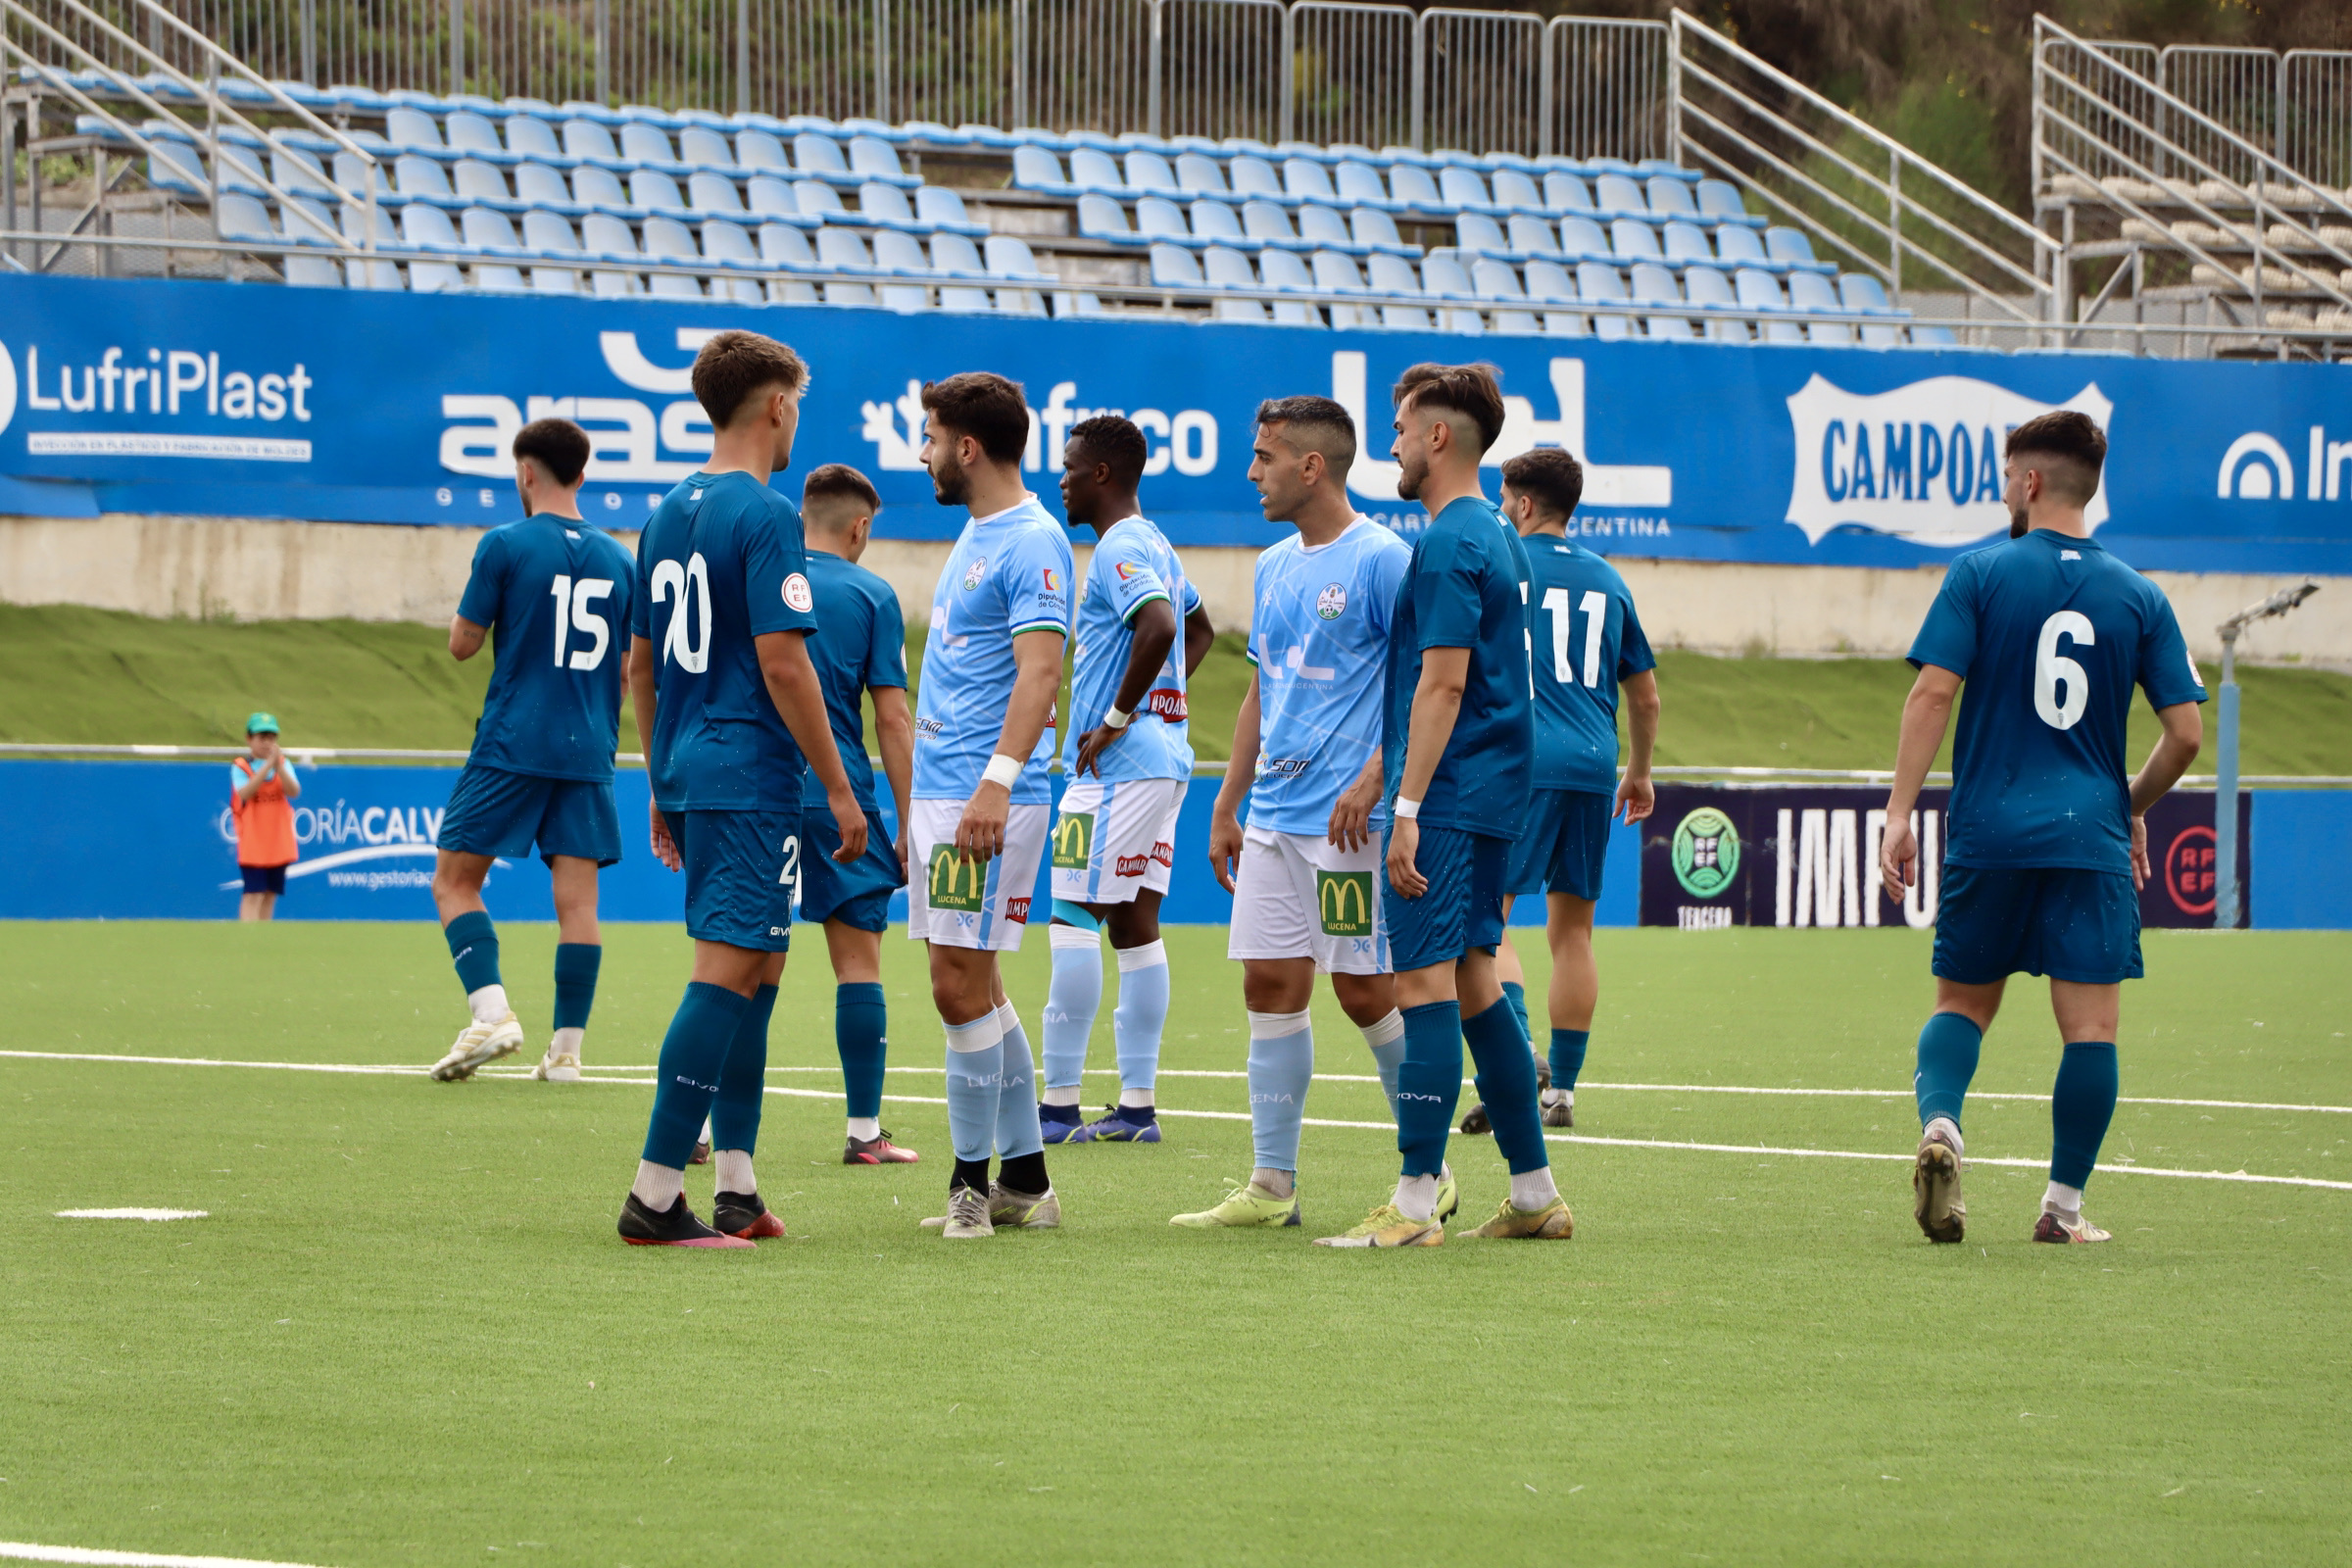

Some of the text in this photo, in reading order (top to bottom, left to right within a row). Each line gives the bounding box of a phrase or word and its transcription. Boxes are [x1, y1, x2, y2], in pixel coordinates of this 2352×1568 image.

[27, 345, 313, 421] LufriPlast
[1822, 419, 2020, 506] CAMPOA
[1565, 516, 1671, 538] CENTINA
[551, 574, 614, 670] 15
[651, 552, 711, 673] 20
[1542, 588, 1606, 688] 11
[2034, 610, 2095, 730] 6
[779, 835, 799, 885] 2
[937, 895, 967, 905] LUCENA
[1776, 809, 1939, 929] IMPU
[1327, 922, 1357, 931] LUCENA
[676, 1074, 719, 1093] GIVO
